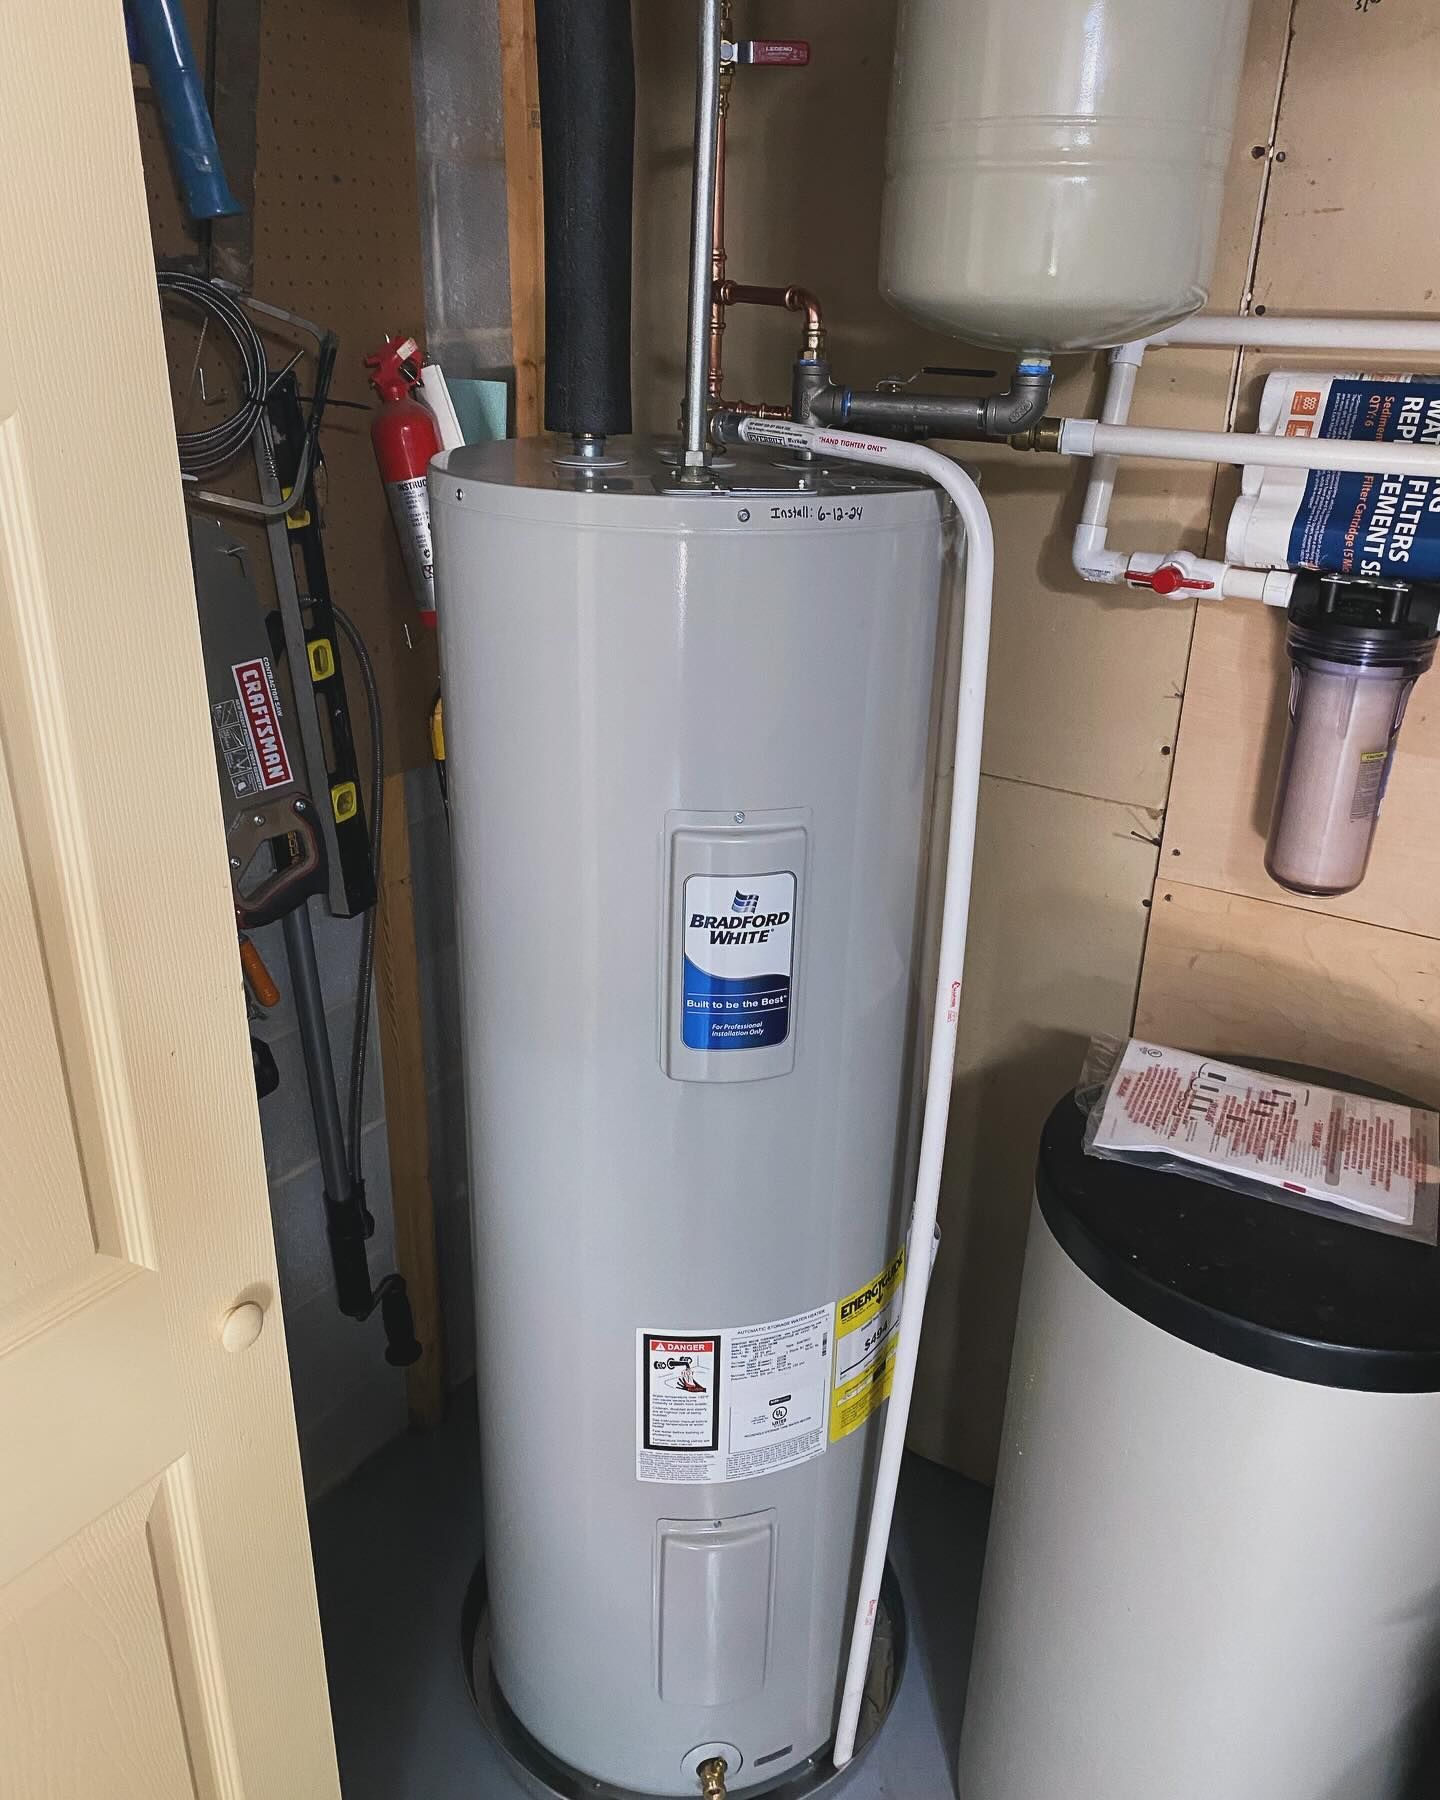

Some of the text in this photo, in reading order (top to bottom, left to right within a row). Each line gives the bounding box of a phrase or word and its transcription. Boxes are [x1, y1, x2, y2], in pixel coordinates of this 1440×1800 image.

[1366, 395, 1381, 418] QTY:
[1375, 396, 1395, 442] Sedimen
[840, 439, 866, 450] TIGHTEN
[1359, 475, 1374, 503] Filter
[770, 505, 864, 521] Install: 6-12-24
[1388, 479, 1429, 563] FILTERS
[1344, 503, 1367, 547] Cartridge
[262, 656, 283, 717] CONTRACTOR SAW
[242, 669, 285, 780] CRAFTSMAN
[690, 911, 790, 930] BRADFORD
[709, 929, 770, 945] WHITE
[686, 995, 784, 1009] Built to be the Best
[723, 1021, 763, 1030] Professional
[749, 1028, 764, 1036] Only
[737, 1309, 826, 1335] AUTOMATIC STORAGE WATER HEATER
[667, 1343, 705, 1351] DANGER
